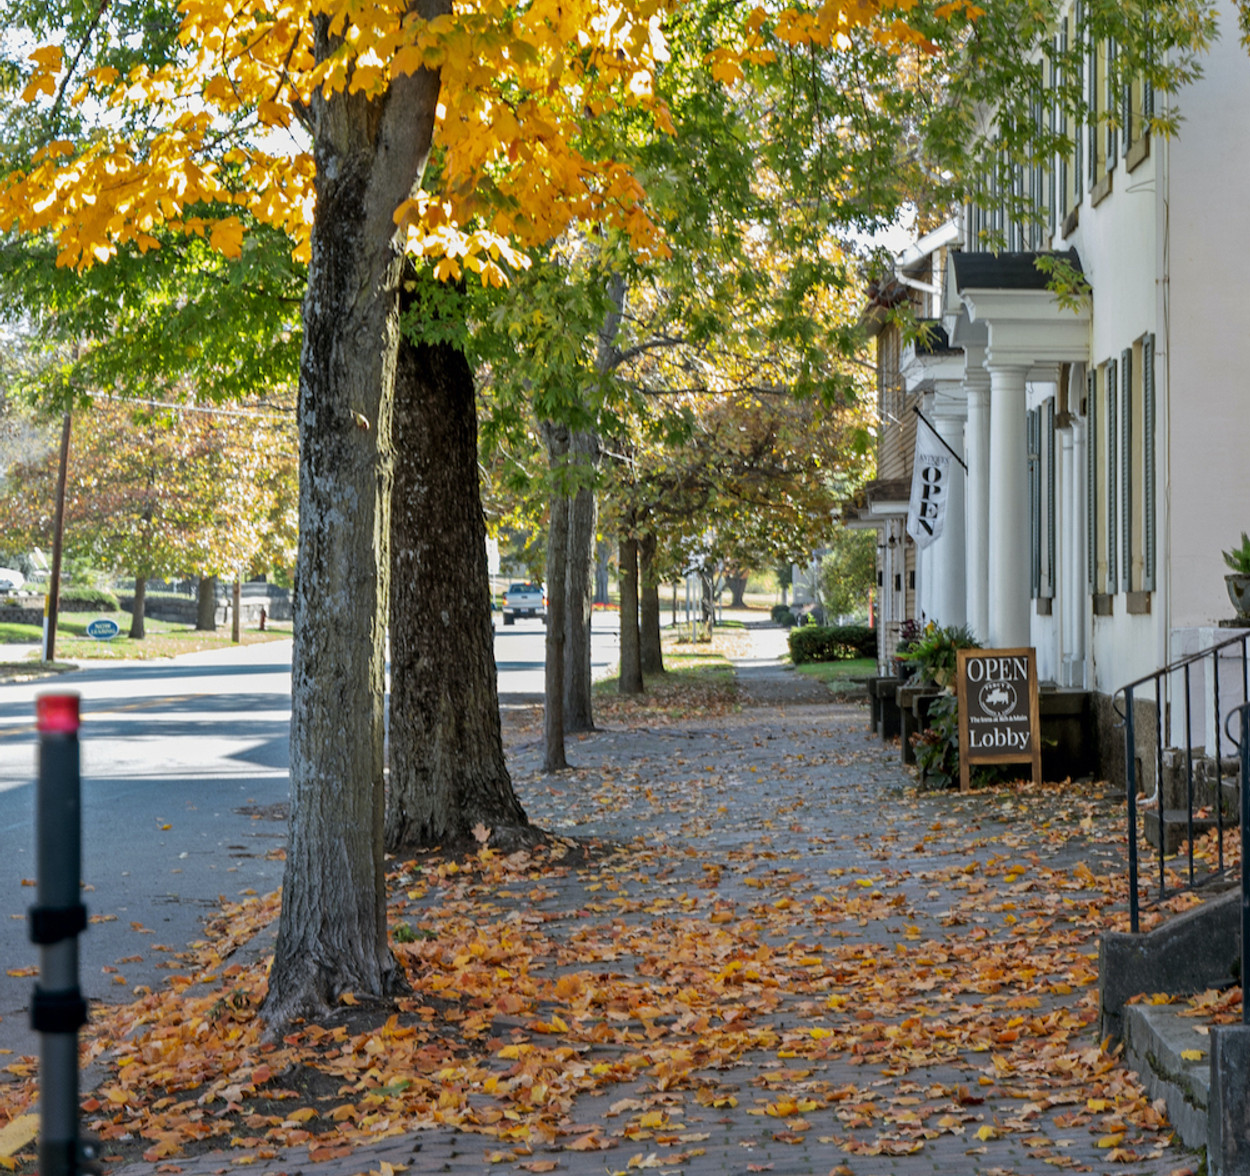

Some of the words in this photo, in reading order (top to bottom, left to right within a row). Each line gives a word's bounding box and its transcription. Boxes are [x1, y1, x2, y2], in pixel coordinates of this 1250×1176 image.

[917, 467, 942, 536] OPEN
[967, 657, 1028, 682] OPEN
[969, 727, 1030, 750] Lobby
